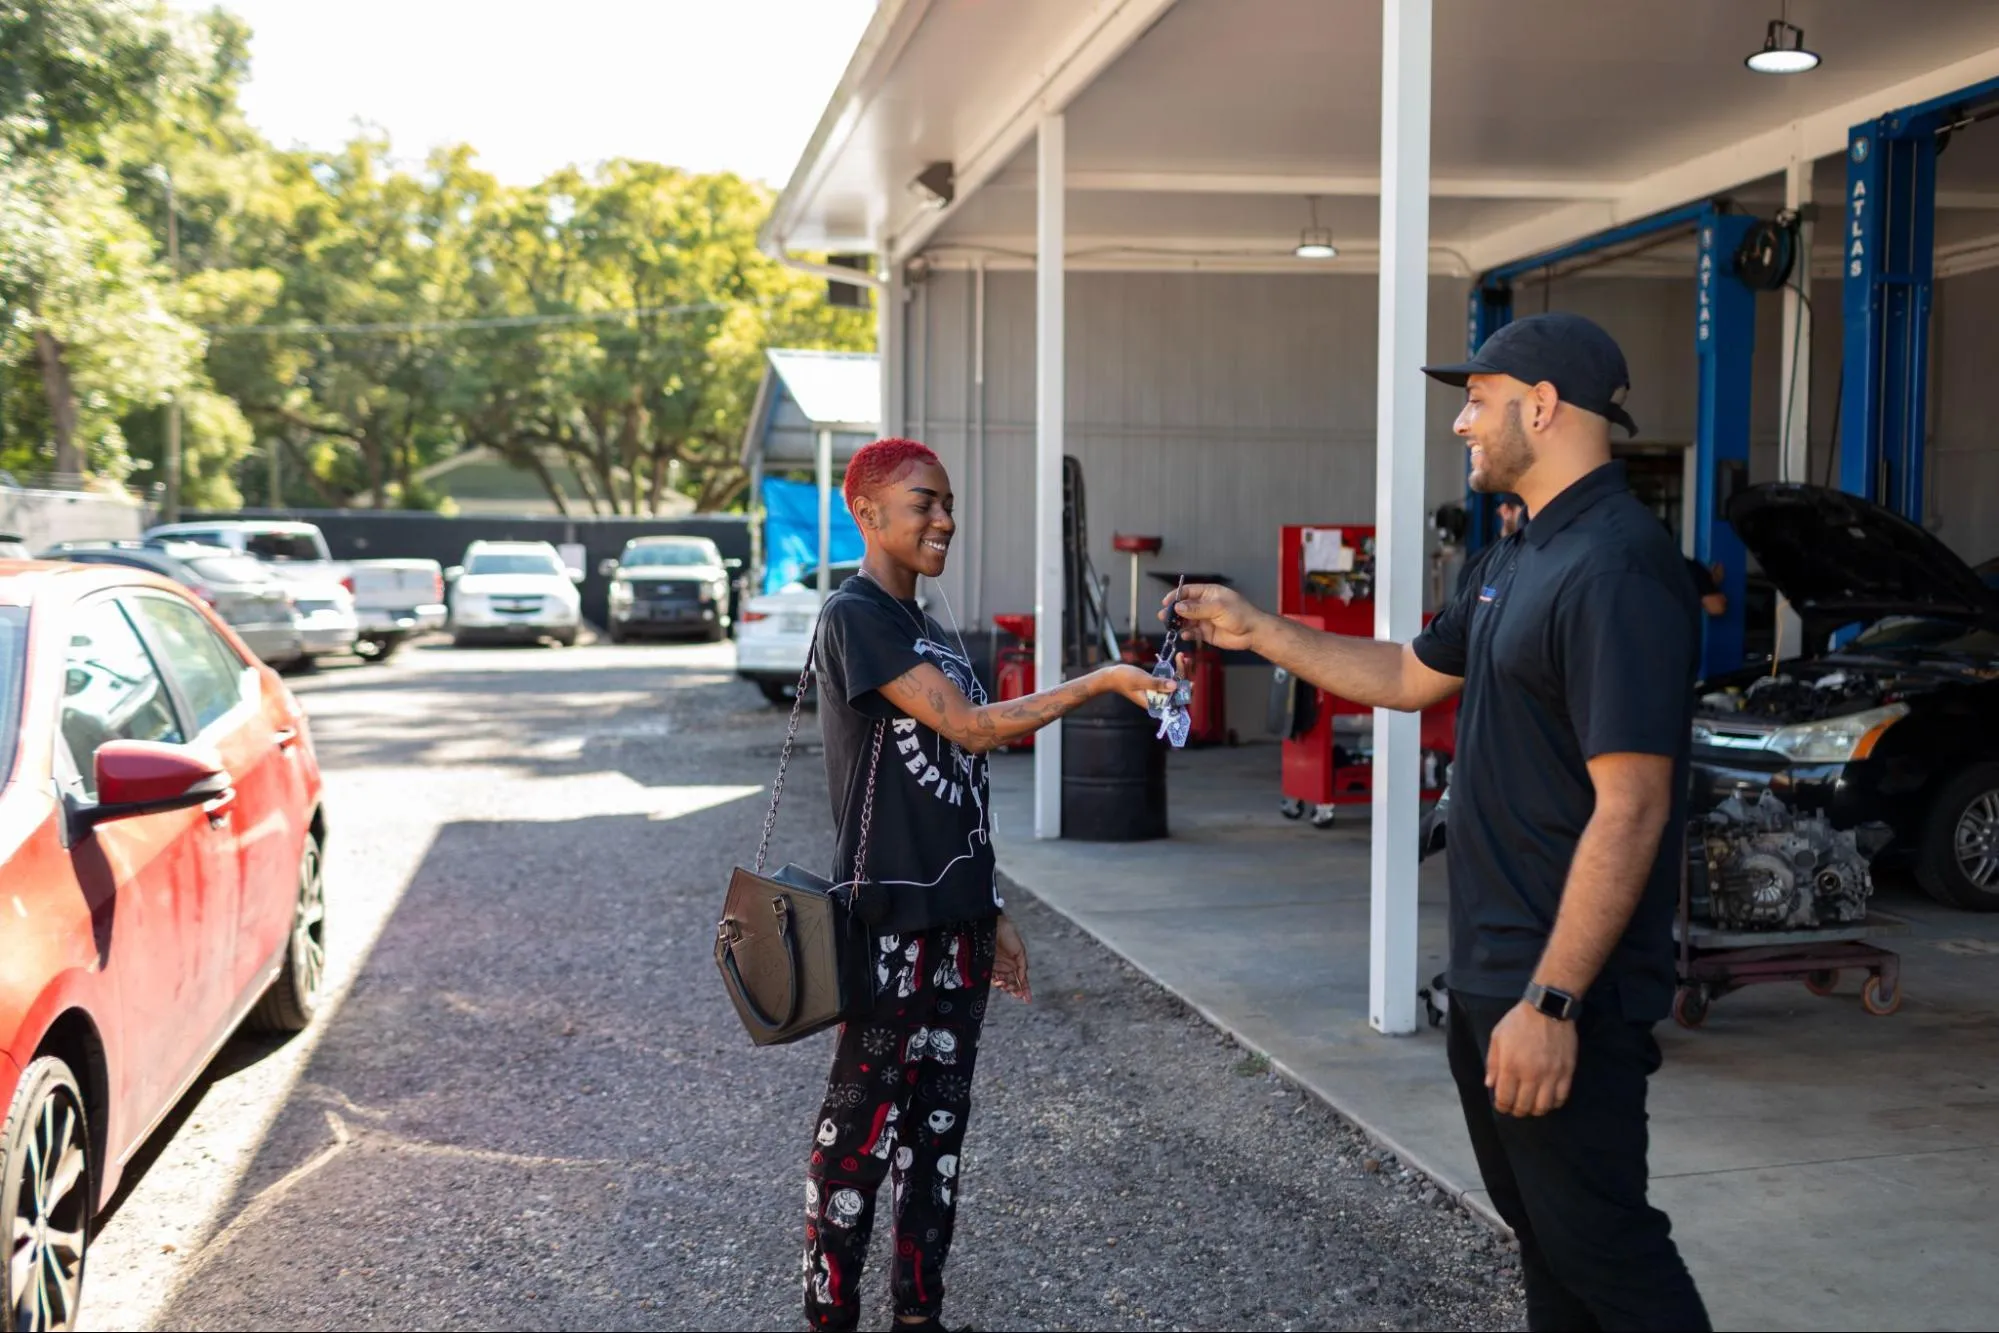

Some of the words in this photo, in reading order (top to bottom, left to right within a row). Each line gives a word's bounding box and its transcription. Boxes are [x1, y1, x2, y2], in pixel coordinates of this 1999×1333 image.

[1850, 180, 1866, 277] ATLAS
[1699, 253, 1711, 341] ATLAS
[892, 718, 963, 807] REEPIN
